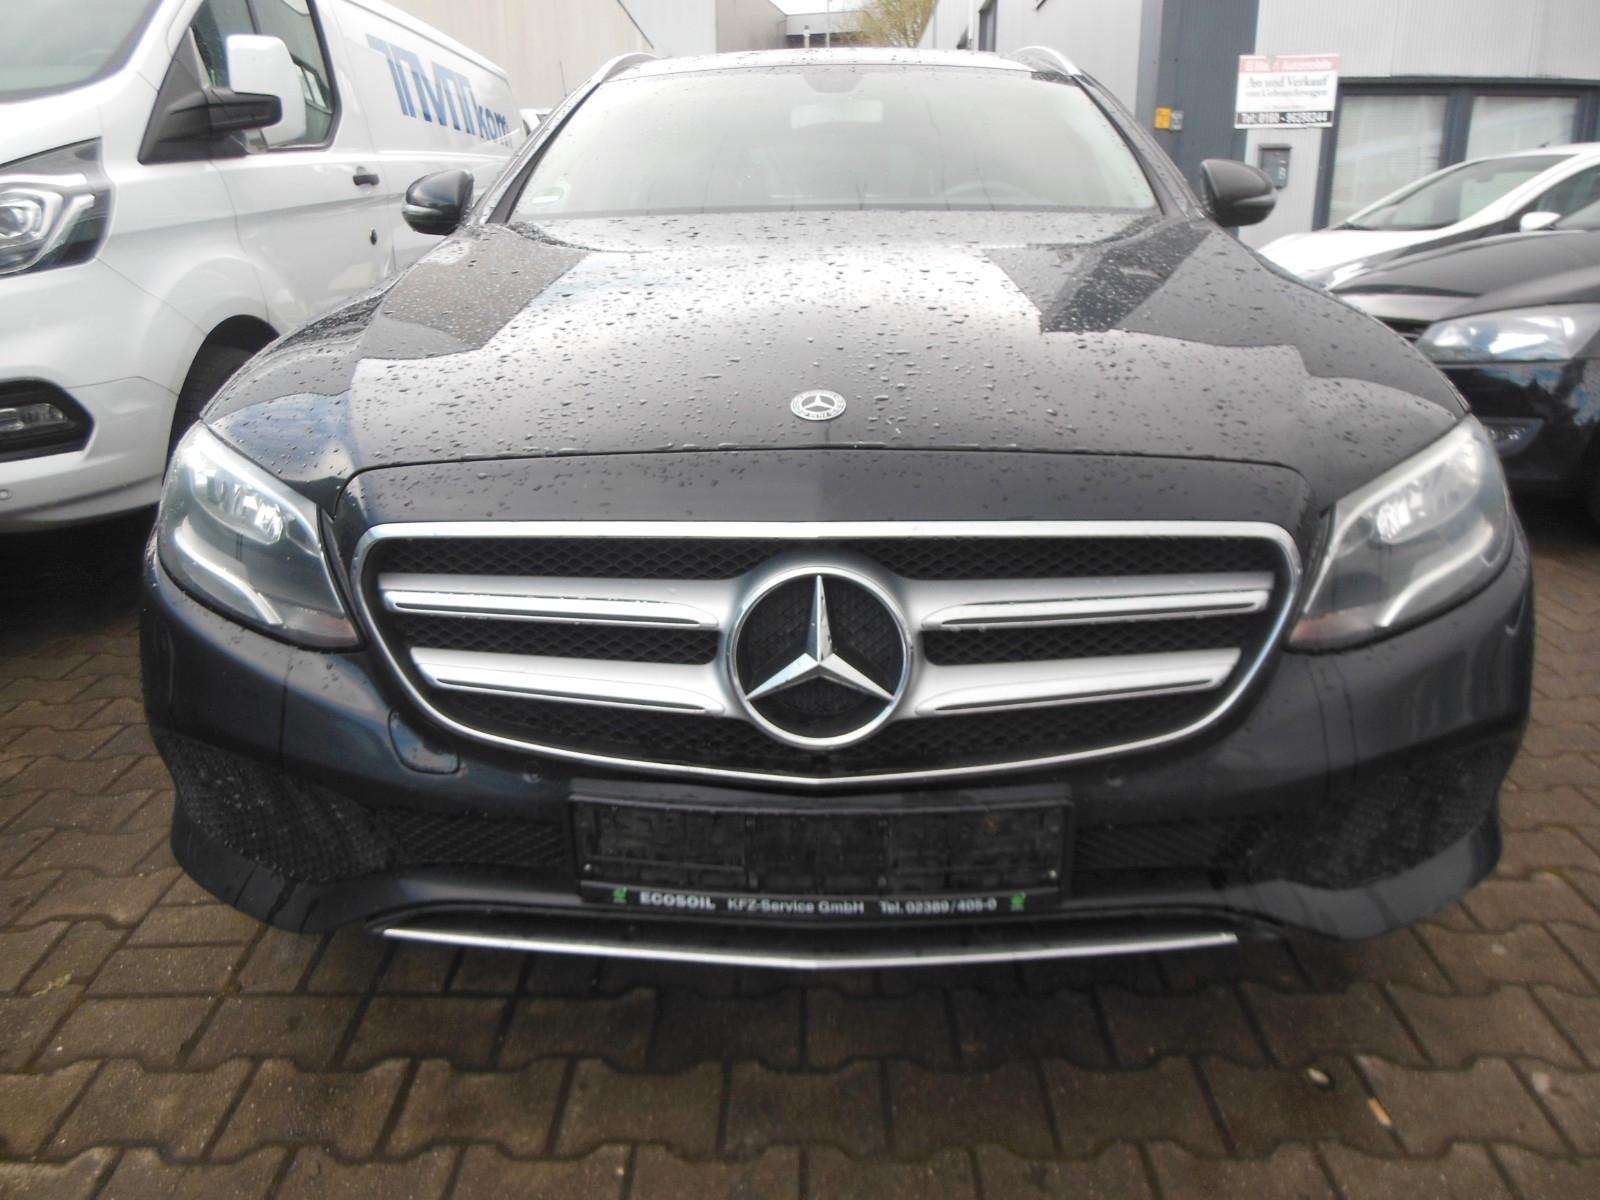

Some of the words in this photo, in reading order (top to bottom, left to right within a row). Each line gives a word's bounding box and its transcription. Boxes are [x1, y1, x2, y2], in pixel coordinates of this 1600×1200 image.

[1246, 77, 1262, 88] An
[1264, 76, 1285, 87] und
[1287, 75, 1329, 87] Verkauf
[640, 891, 716, 910] ECOSOIL
[728, 897, 815, 913] KFZ-Service
[818, 900, 865, 914] GmbH
